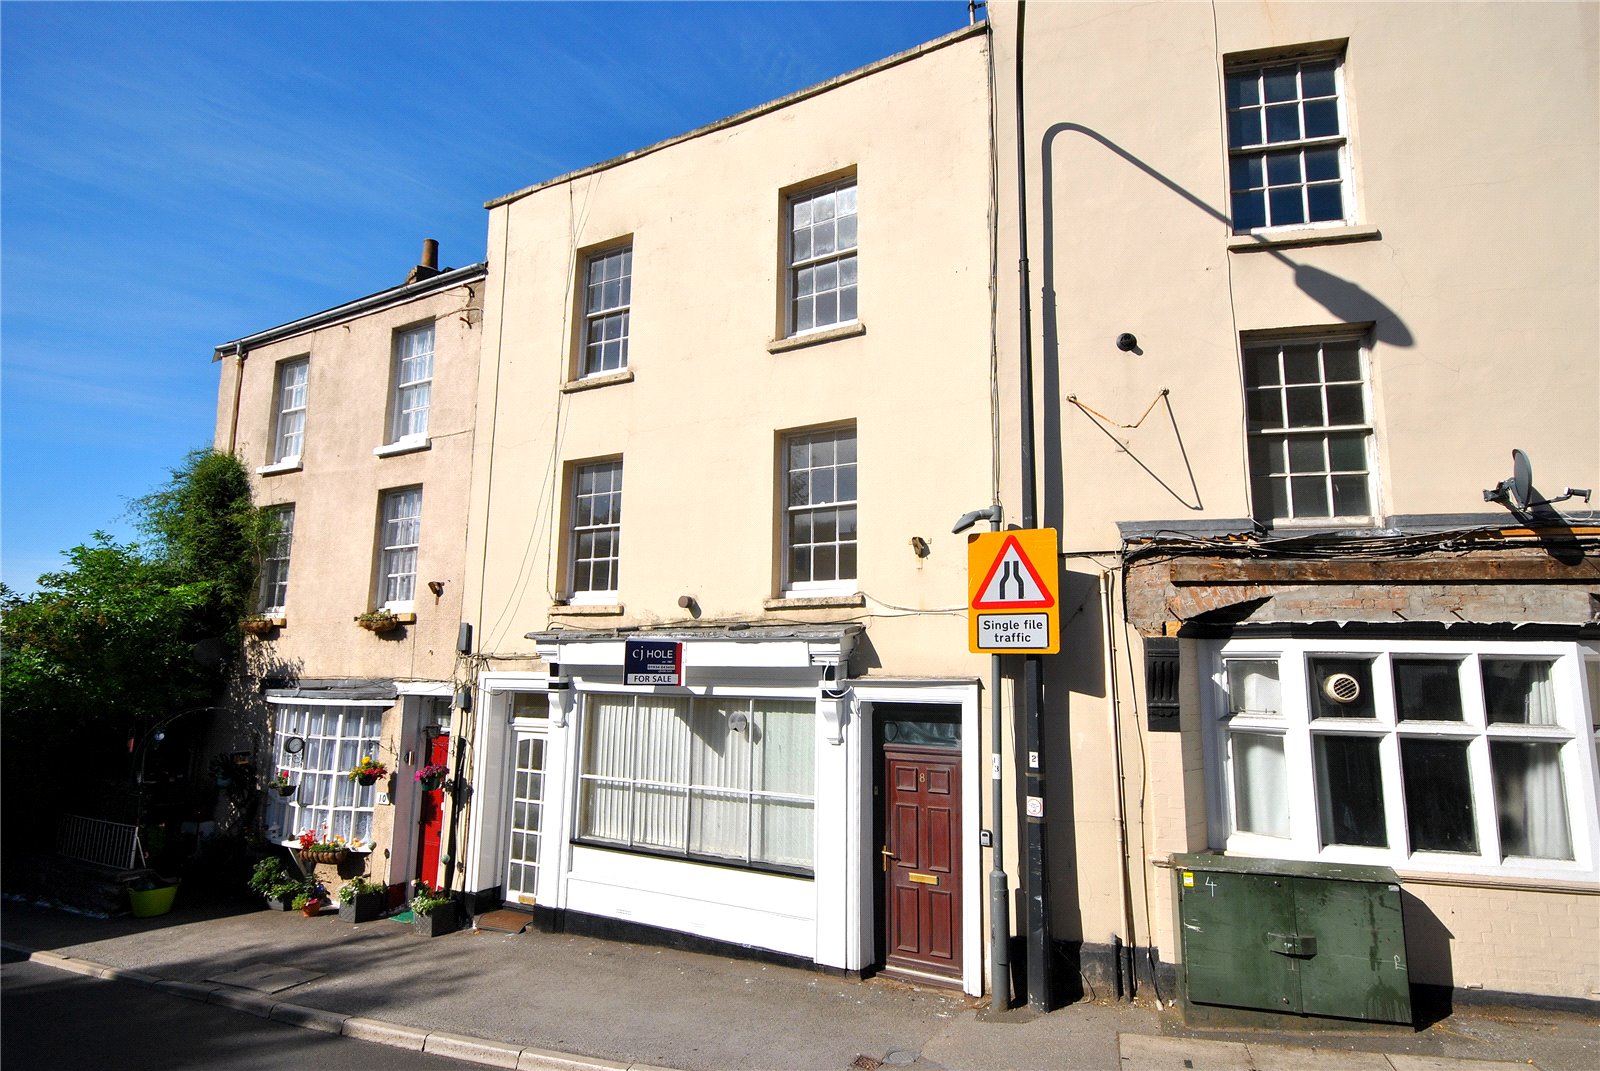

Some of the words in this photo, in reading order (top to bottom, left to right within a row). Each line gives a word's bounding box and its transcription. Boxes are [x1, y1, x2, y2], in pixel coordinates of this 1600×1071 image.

[983, 620, 1019, 631] Single
[1024, 619, 1043, 629] file
[994, 632, 1031, 642] traffic
[646, 649, 673, 659] HOLE
[1031, 754, 1037, 762] 2
[919, 772, 925, 783] 8
[378, 794, 387, 803] 10
[1205, 876, 1217, 897] 4
